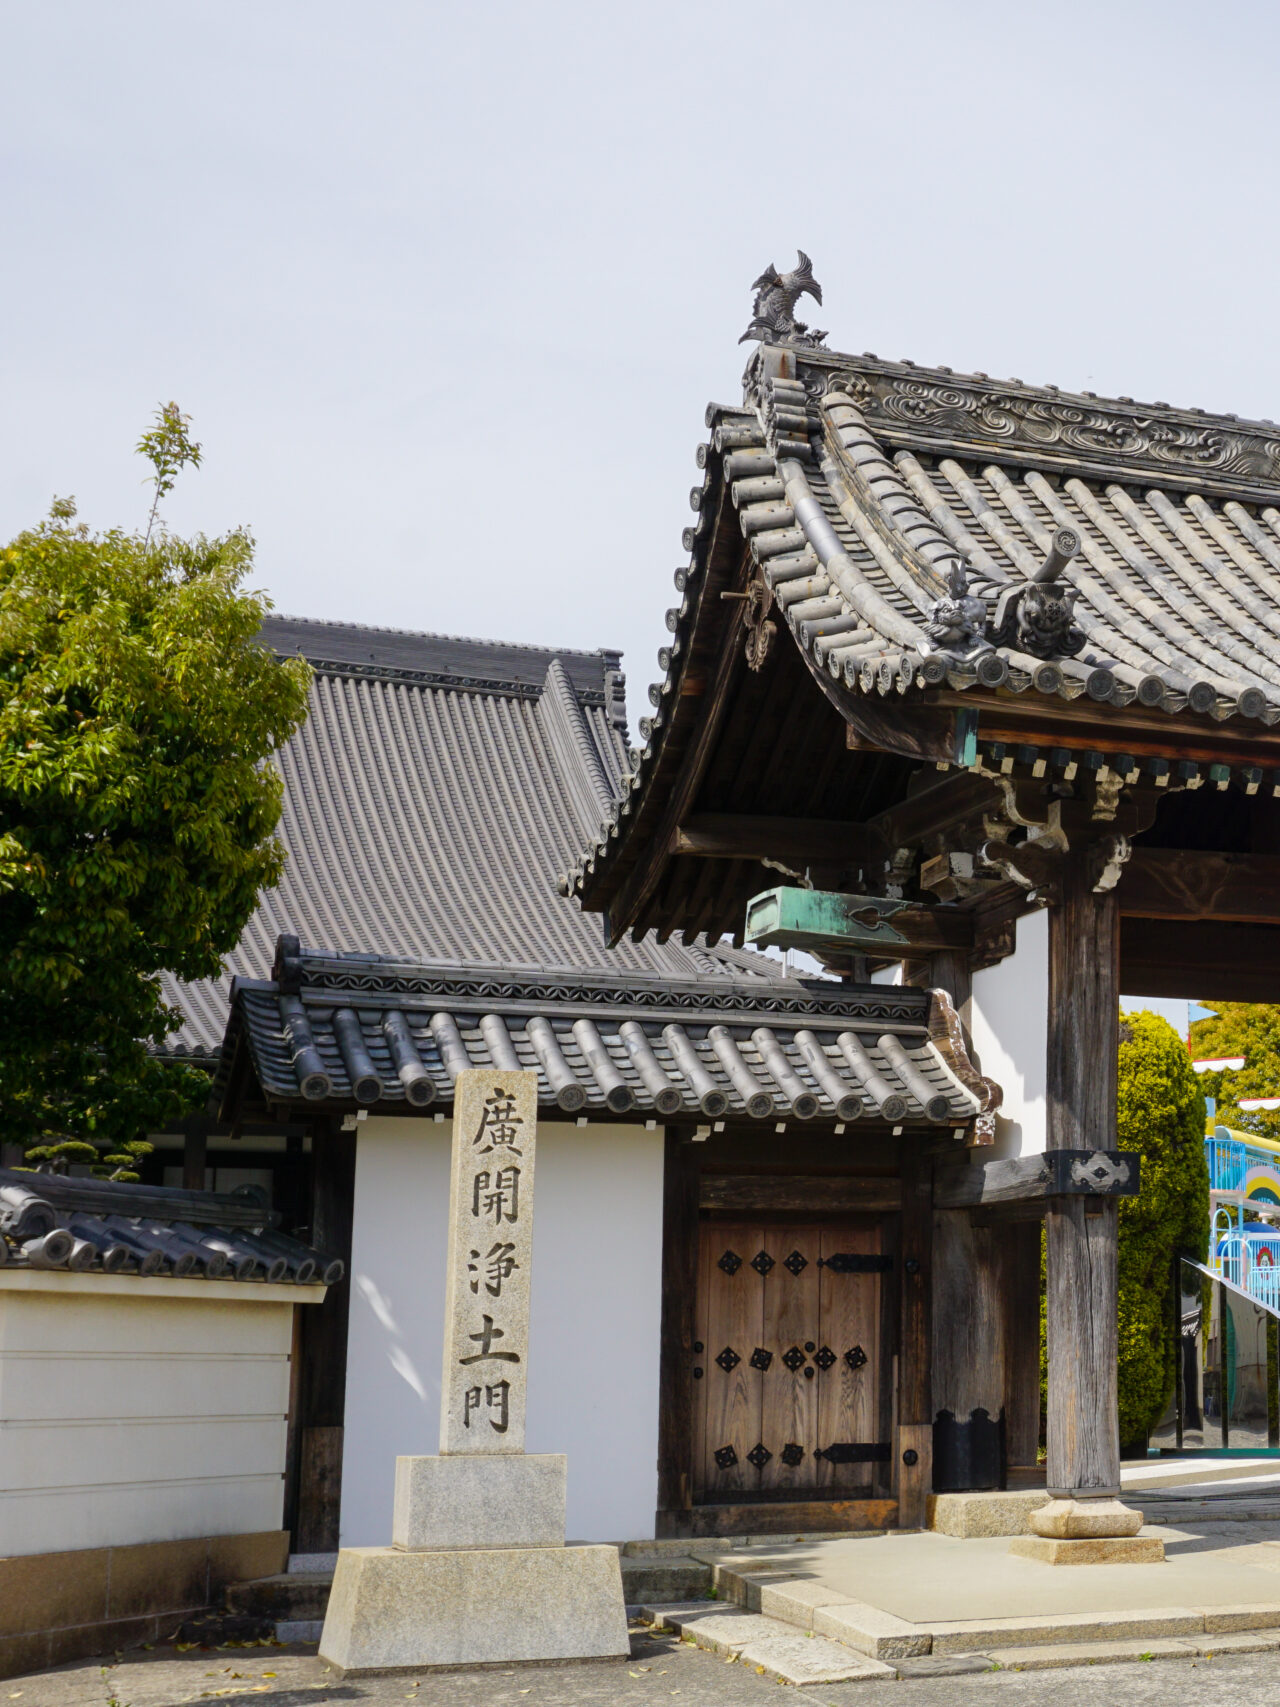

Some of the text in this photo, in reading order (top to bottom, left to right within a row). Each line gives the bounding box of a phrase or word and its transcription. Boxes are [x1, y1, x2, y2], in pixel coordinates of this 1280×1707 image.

[458, 1087, 524, 1434] 廣開浄土門
